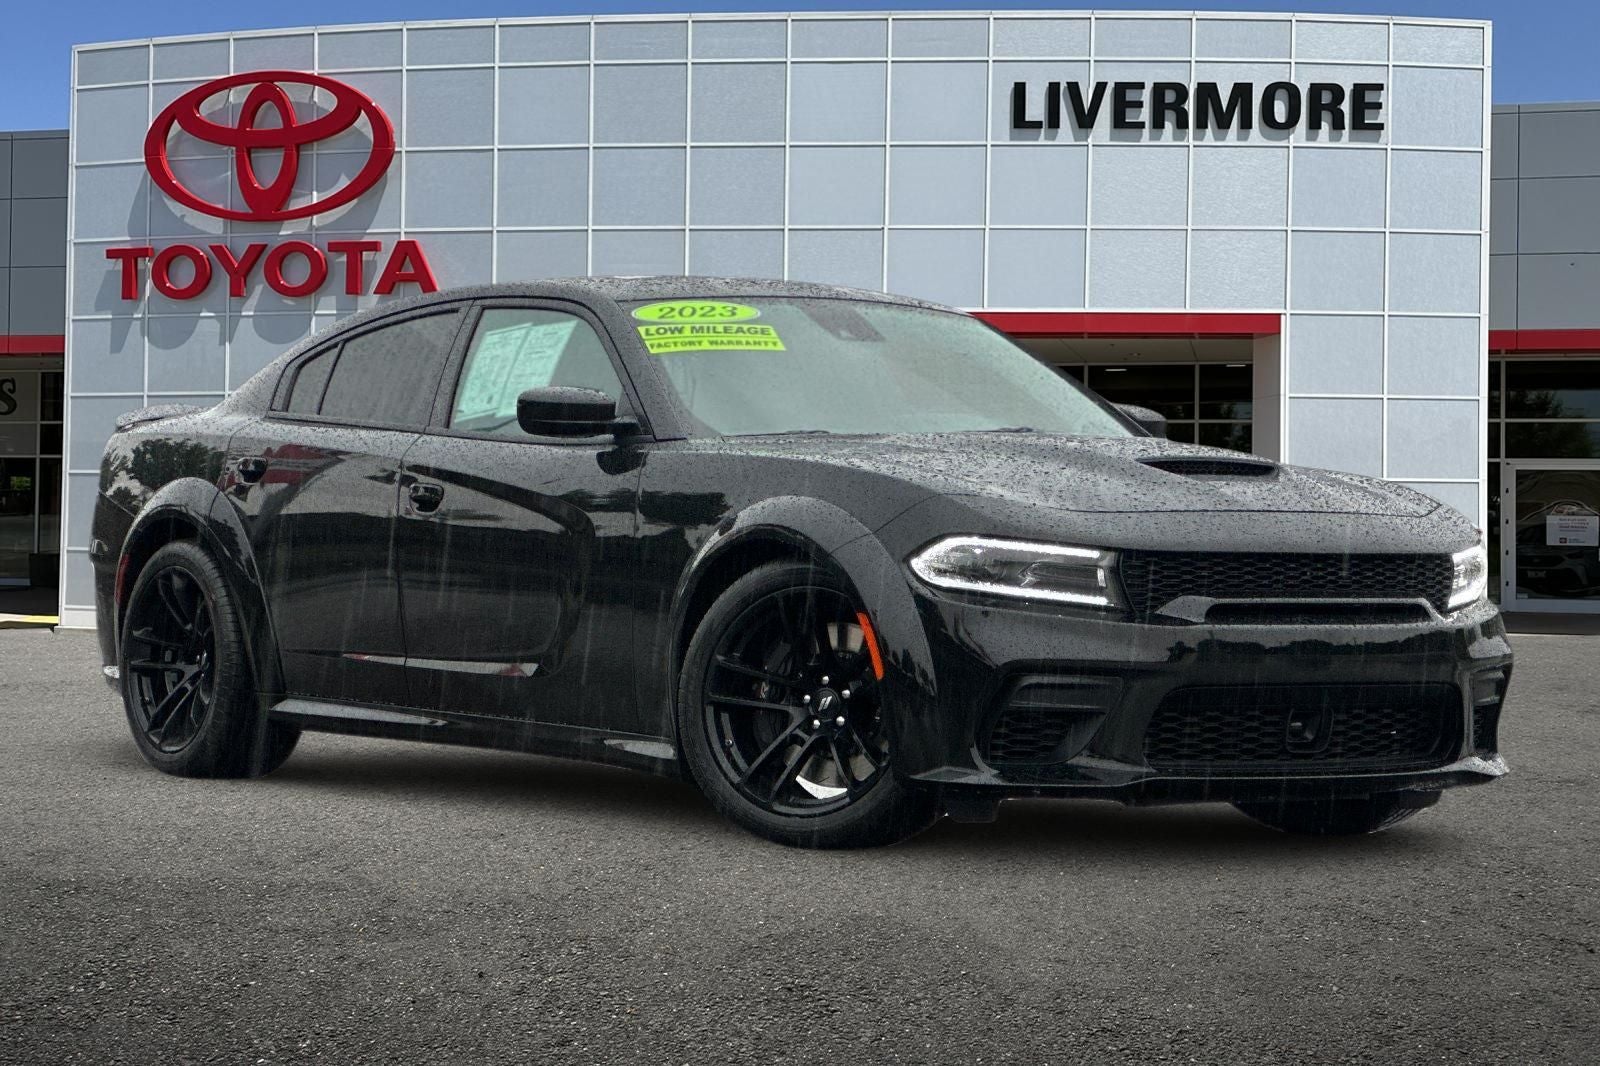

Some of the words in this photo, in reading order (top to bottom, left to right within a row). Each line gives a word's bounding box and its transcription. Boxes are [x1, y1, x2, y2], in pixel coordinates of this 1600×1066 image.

[1012, 81, 1385, 131] LIVERMORE
[105, 240, 439, 300] TOYOTA
[657, 305, 738, 319] 2023
[644, 326, 685, 337] LOW
[690, 325, 772, 336] MILEAGE
[649, 340, 703, 350] FACTORY
